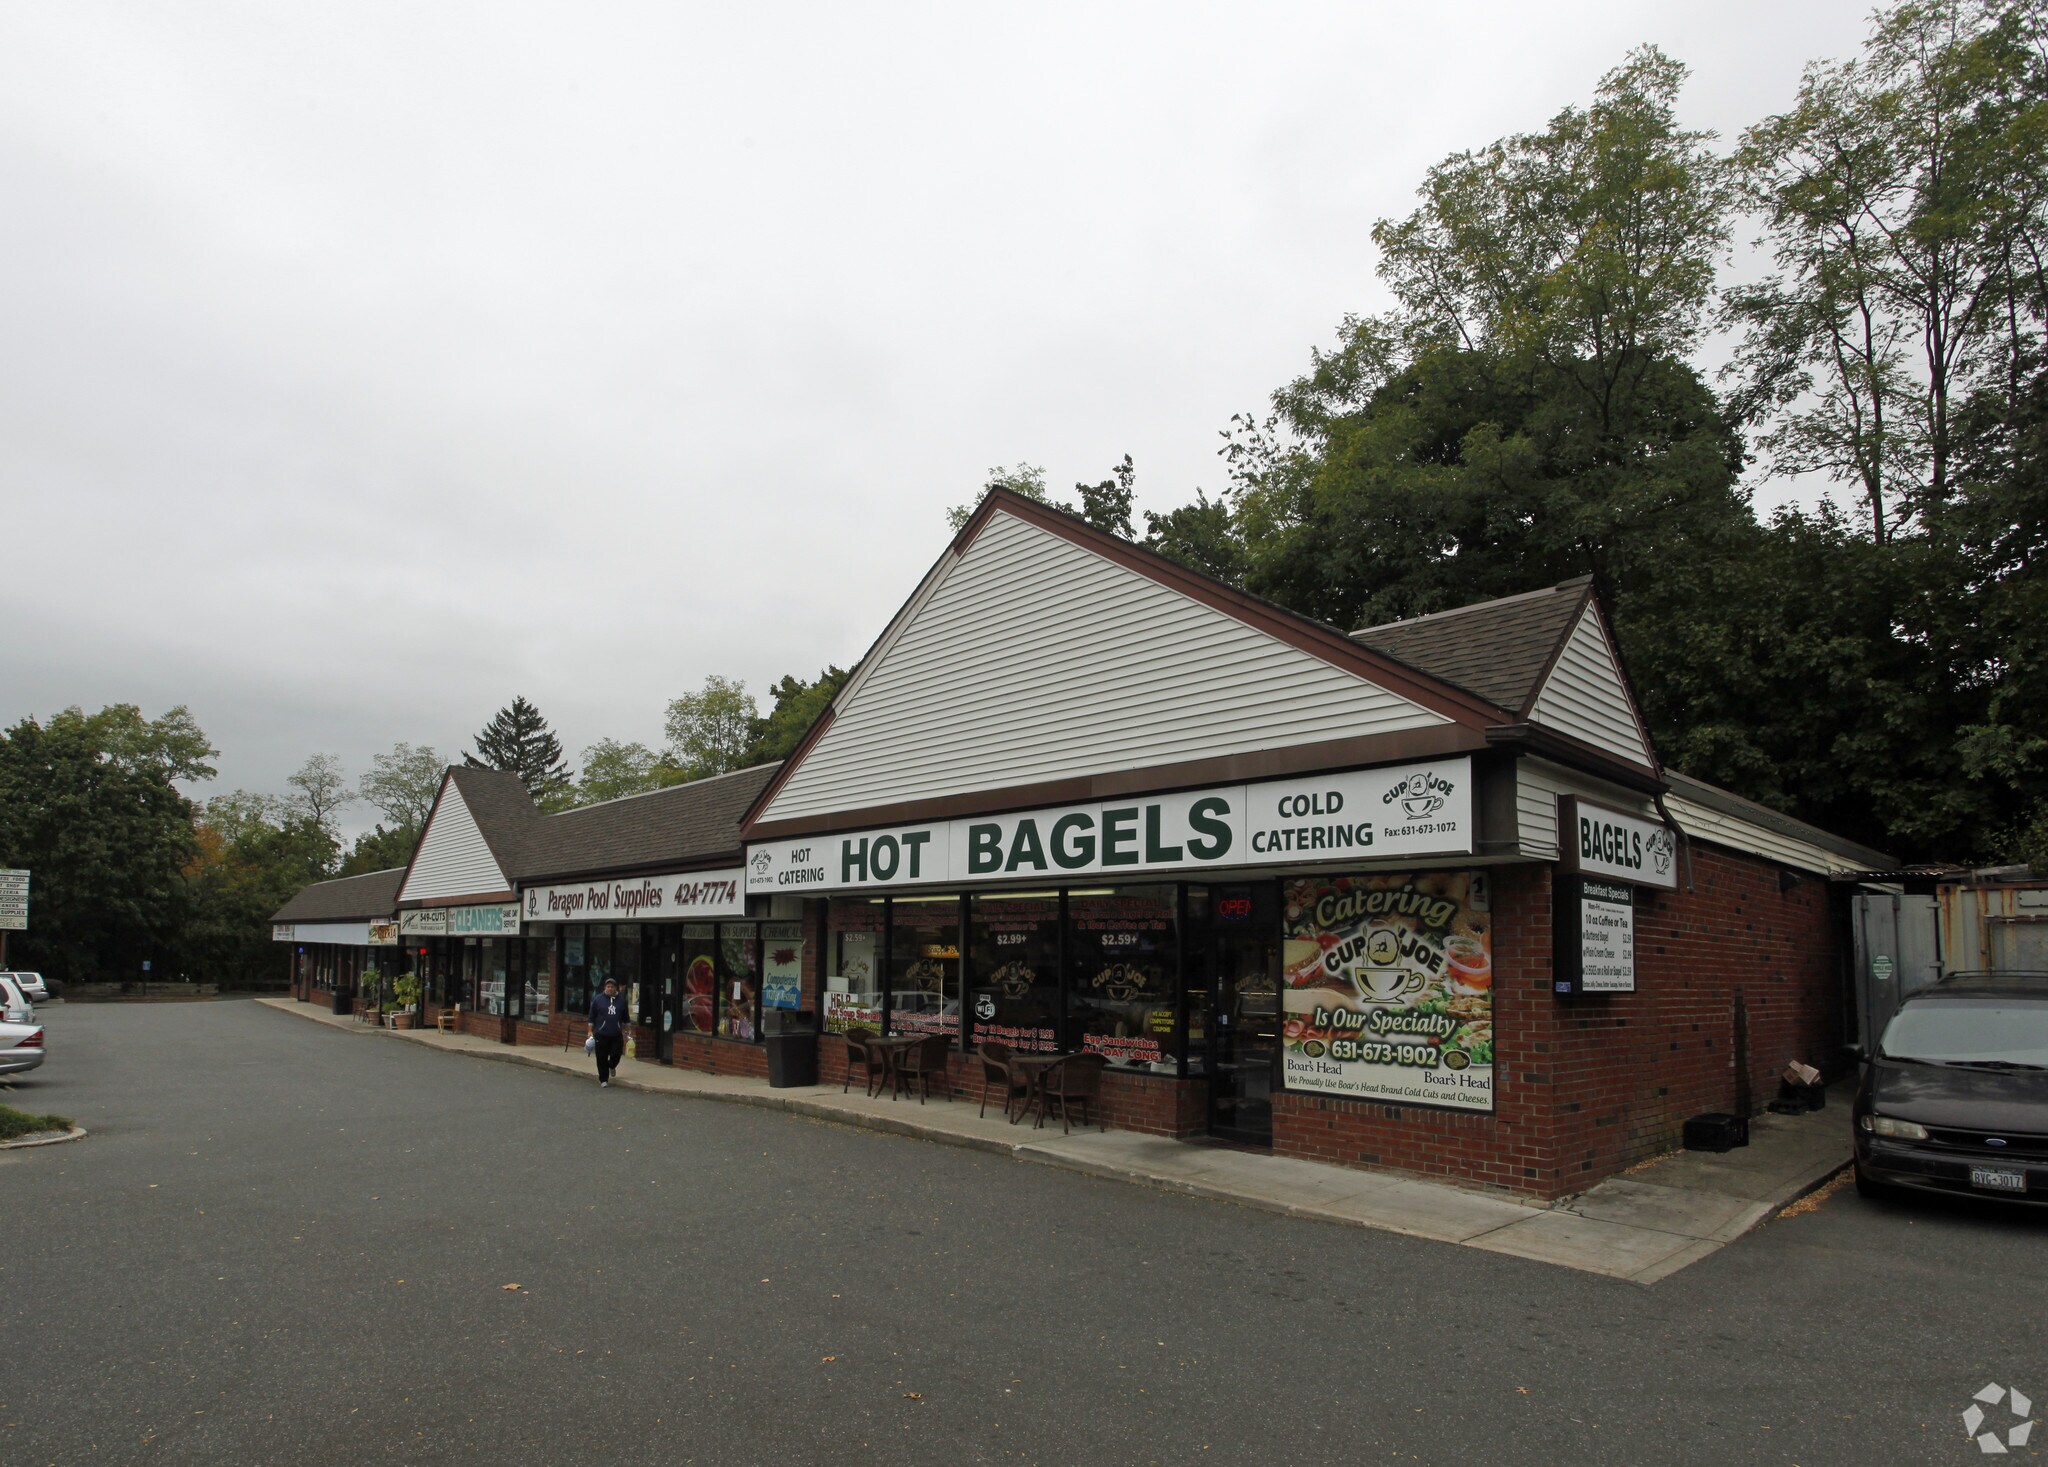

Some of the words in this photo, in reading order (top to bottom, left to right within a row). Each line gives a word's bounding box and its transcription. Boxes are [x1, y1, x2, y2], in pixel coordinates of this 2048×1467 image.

[1382, 781, 1408, 805] CUP
[1278, 791, 1344, 818] COLD
[1251, 822, 1373, 853] CATERING
[1384, 827, 1400, 837] Fax:
[1401, 821, 1456, 836] 631-673-1072
[842, 830, 930, 883] HOT
[968, 797, 1232, 874] BAGELS
[1580, 816, 1642, 870] BAGELS
[791, 848, 811, 863] HOT
[778, 867, 825, 885] CATERING
[547, 888, 584, 918] Paragon
[587, 883, 610, 911] Pool
[613, 879, 663, 917] Supplies
[674, 879, 737, 906] 424-7774
[1583, 881, 1608, 897] Breakfast
[1608, 886, 1629, 901] Specials
[1114, 898, 1161, 908] SPECIAL
[1316, 884, 1456, 928] Catering
[455, 907, 503, 931] CLEANERS
[503, 920, 516, 928] SERVICE
[1150, 919, 1166, 930] Tea
[1591, 916, 1598, 925] oz
[1598, 915, 1613, 927] Coffee
[1613, 919, 1619, 927] or
[1619, 917, 1628, 928] Tea
[997, 934, 1027, 945] $2.99+
[1101, 934, 1137, 946] $2.59+
[1324, 935, 1367, 972] CUP
[990, 965, 1007, 984] CUP
[1091, 968, 1112, 988] CUP
[828, 1006, 839, 1016] Hot
[839, 1008, 855, 1019] Soup
[856, 1010, 882, 1021] Specials
[1314, 1006, 1328, 1027] Is
[1332, 1007, 1367, 1029] Our
[1369, 1009, 1456, 1039] Specialty
[973, 1023, 988, 1034] Buy
[996, 1025, 1019, 1038] Bagels
[1020, 1027, 1032, 1037] for
[1018, 1038, 1030, 1049] for
[1083, 1033, 1101, 1045] Egg
[1102, 1034, 1159, 1050] Sandwiches
[1082, 1045, 1102, 1055] ALL
[1104, 1046, 1125, 1058] DAY
[1331, 1039, 1438, 1066] 631-673-1902
[1287, 1058, 1314, 1072] Boar's
[1316, 1061, 1342, 1076] Head
[1423, 1070, 1457, 1086] Boar's
[1459, 1074, 1491, 1090] Head
[1287, 1075, 1298, 1084] We
[1298, 1076, 1324, 1088] Proudly
[1325, 1078, 1337, 1088] Use
[1338, 1079, 1359, 1092] Boar's
[1360, 1082, 1379, 1093] Head
[1380, 1084, 1403, 1096] Brand
[1404, 1086, 1421, 1097] Cold
[1422, 1088, 1439, 1099] Cuts
[1440, 1091, 1456, 1101] and
[1457, 1091, 1490, 1105] Cheeses.
